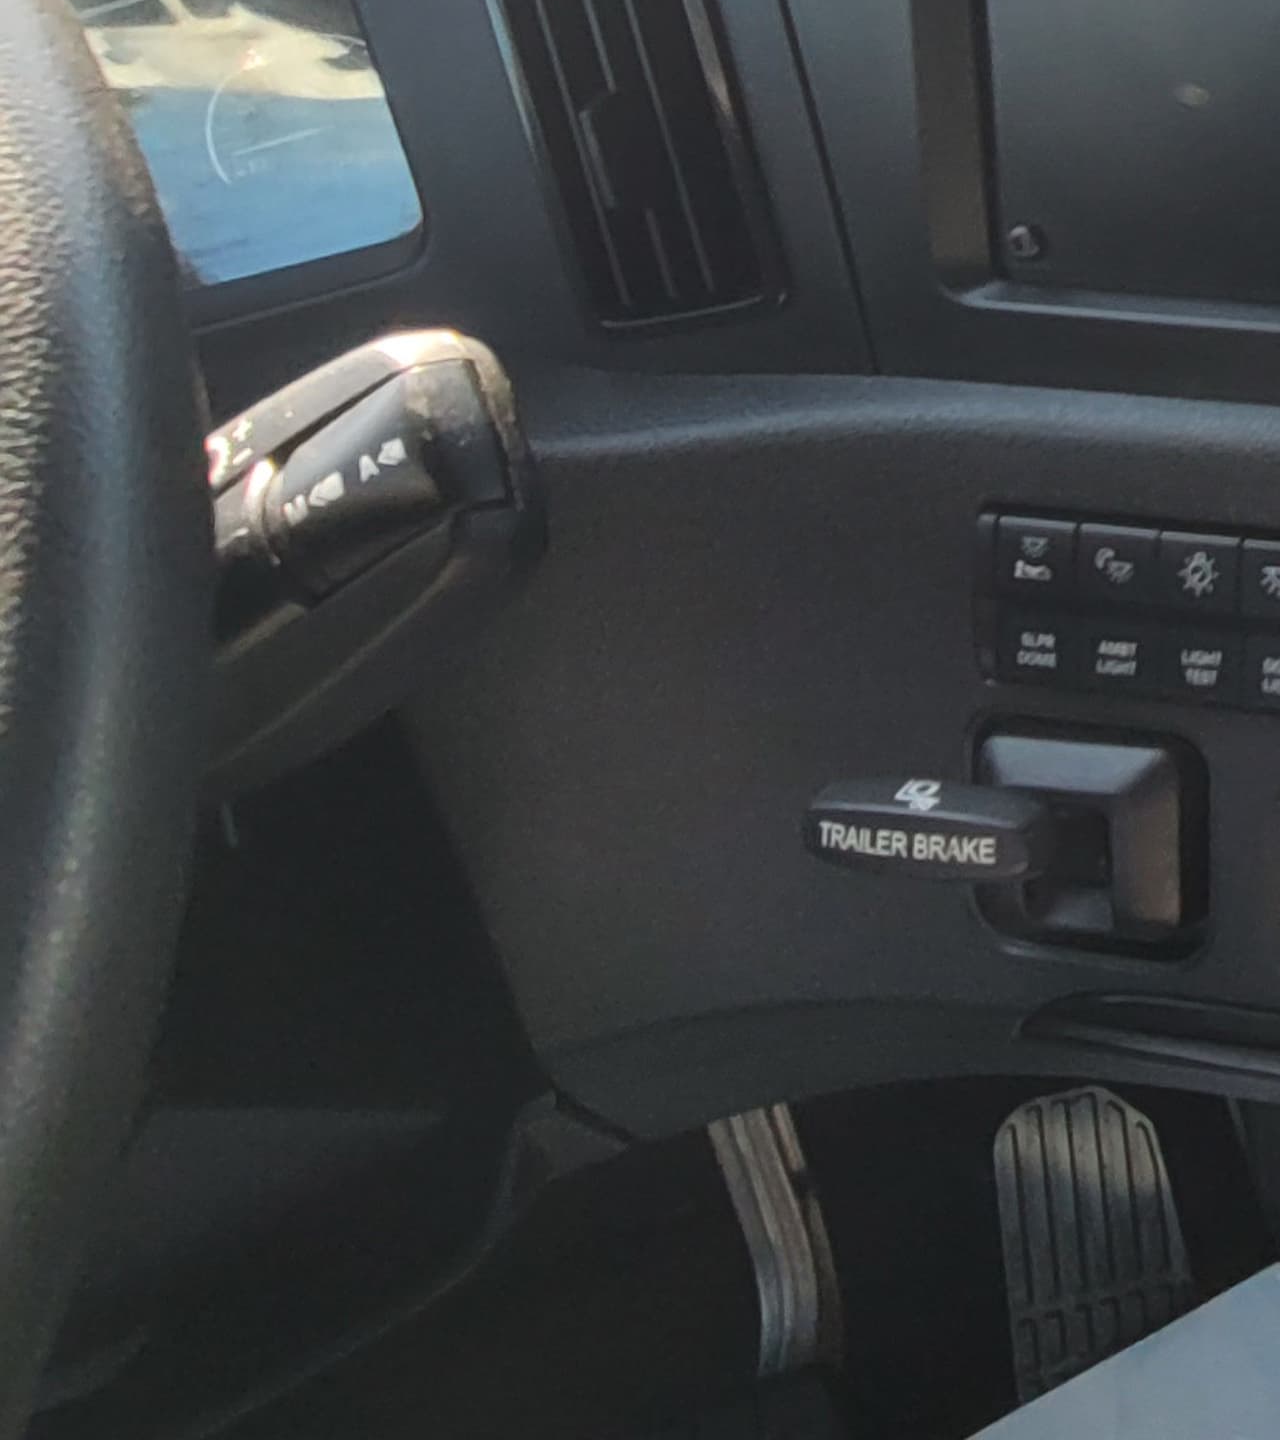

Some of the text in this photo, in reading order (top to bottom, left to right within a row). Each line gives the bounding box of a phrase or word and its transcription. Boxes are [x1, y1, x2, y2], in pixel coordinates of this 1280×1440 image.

[1180, 648, 1223, 667] LIGHT
[818, 820, 998, 865] TRAILER BRAKE
